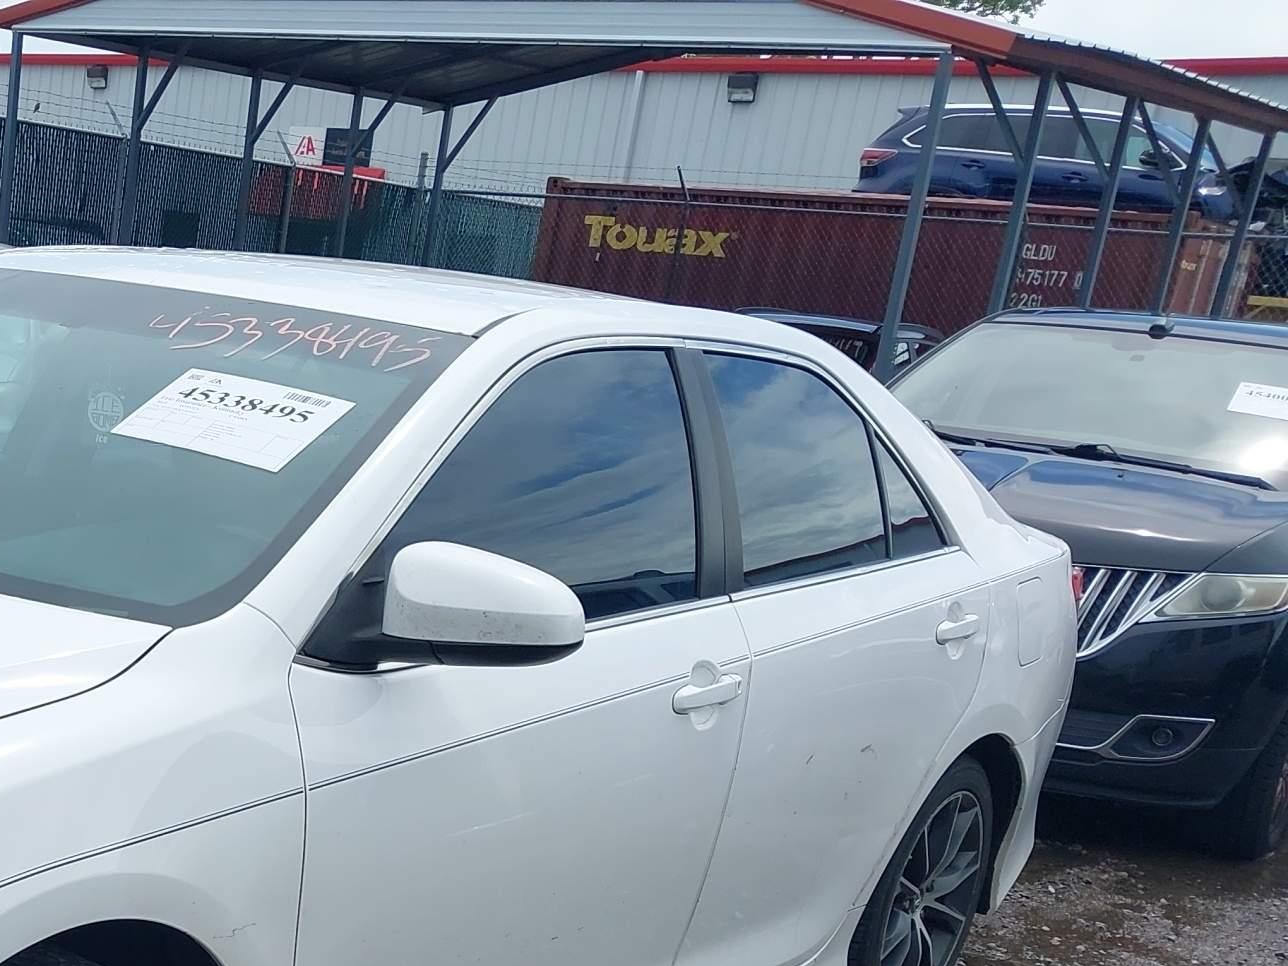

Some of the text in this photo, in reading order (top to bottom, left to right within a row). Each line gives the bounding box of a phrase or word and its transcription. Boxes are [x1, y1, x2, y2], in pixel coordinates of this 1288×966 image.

[584, 215, 730, 259] Touax
[1022, 243, 1057, 261] GLDU
[149, 313, 443, 372] 45338495
[178, 387, 315, 423] 45338495
